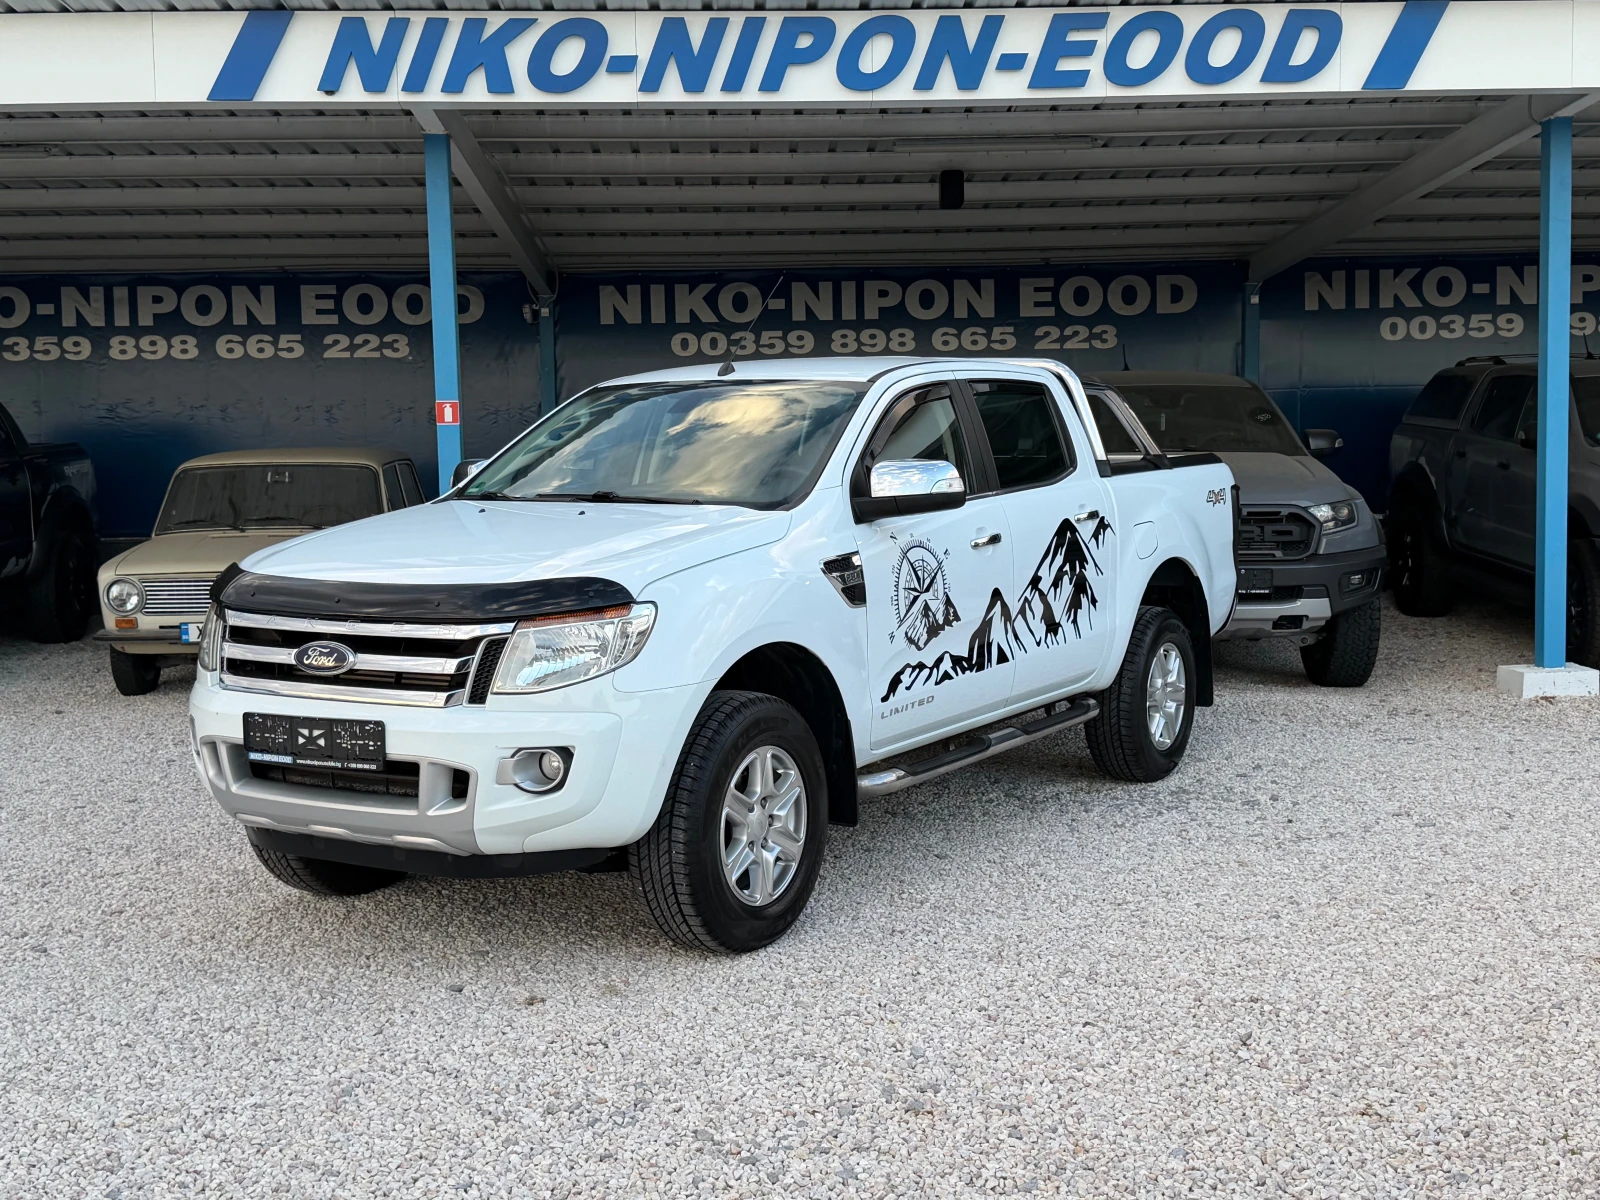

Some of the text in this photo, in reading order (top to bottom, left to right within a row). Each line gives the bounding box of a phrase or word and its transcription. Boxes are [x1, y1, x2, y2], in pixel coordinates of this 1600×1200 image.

[317, 8, 1343, 92] NIKO-NIPON-EOOD
[599, 274, 1198, 325] NIKO-NIPON EOOD
[670, 325, 1118, 357] 00359 898 665 223
[1379, 312, 1524, 341] 00359
[108, 334, 199, 360] 898
[215, 334, 305, 359] 665
[322, 333, 410, 358] 223
[303, 646, 338, 667] Ford
[880, 695, 935, 720] LIMITED
